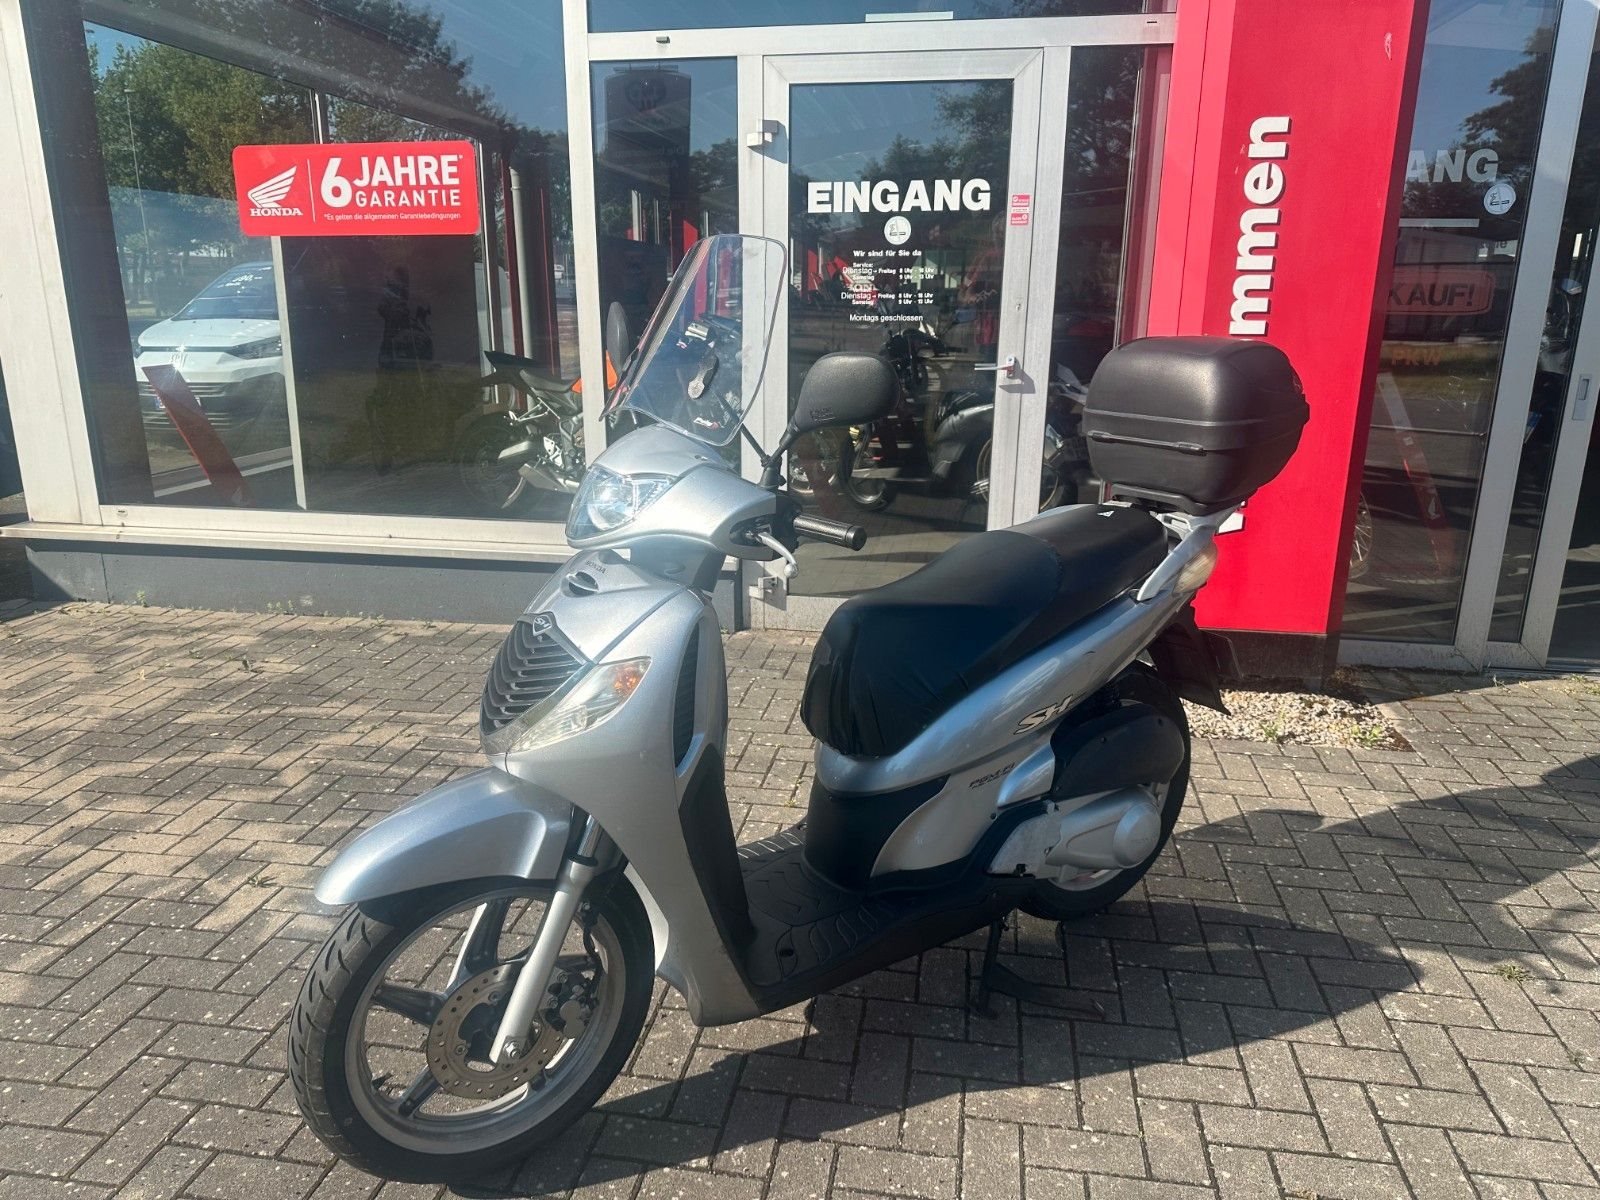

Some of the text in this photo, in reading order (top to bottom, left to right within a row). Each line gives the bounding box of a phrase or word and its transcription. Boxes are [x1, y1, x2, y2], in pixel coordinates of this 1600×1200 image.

[320, 157, 352, 208] 6
[355, 189, 462, 208] GARANTIE
[807, 178, 991, 214] EINGANG
[249, 207, 304, 217] HONDA
[335, 213, 353, 222] gelten
[363, 213, 399, 222] allgemeinen
[399, 212, 461, 221] Garantiebedingungen
[853, 249, 922, 257] Wir sind für Sie da
[842, 267, 873, 275] Dienstag
[841, 292, 871, 300] Dienstag
[850, 313, 924, 323] Montags geschlossen
[1013, 693, 1073, 735] SH
